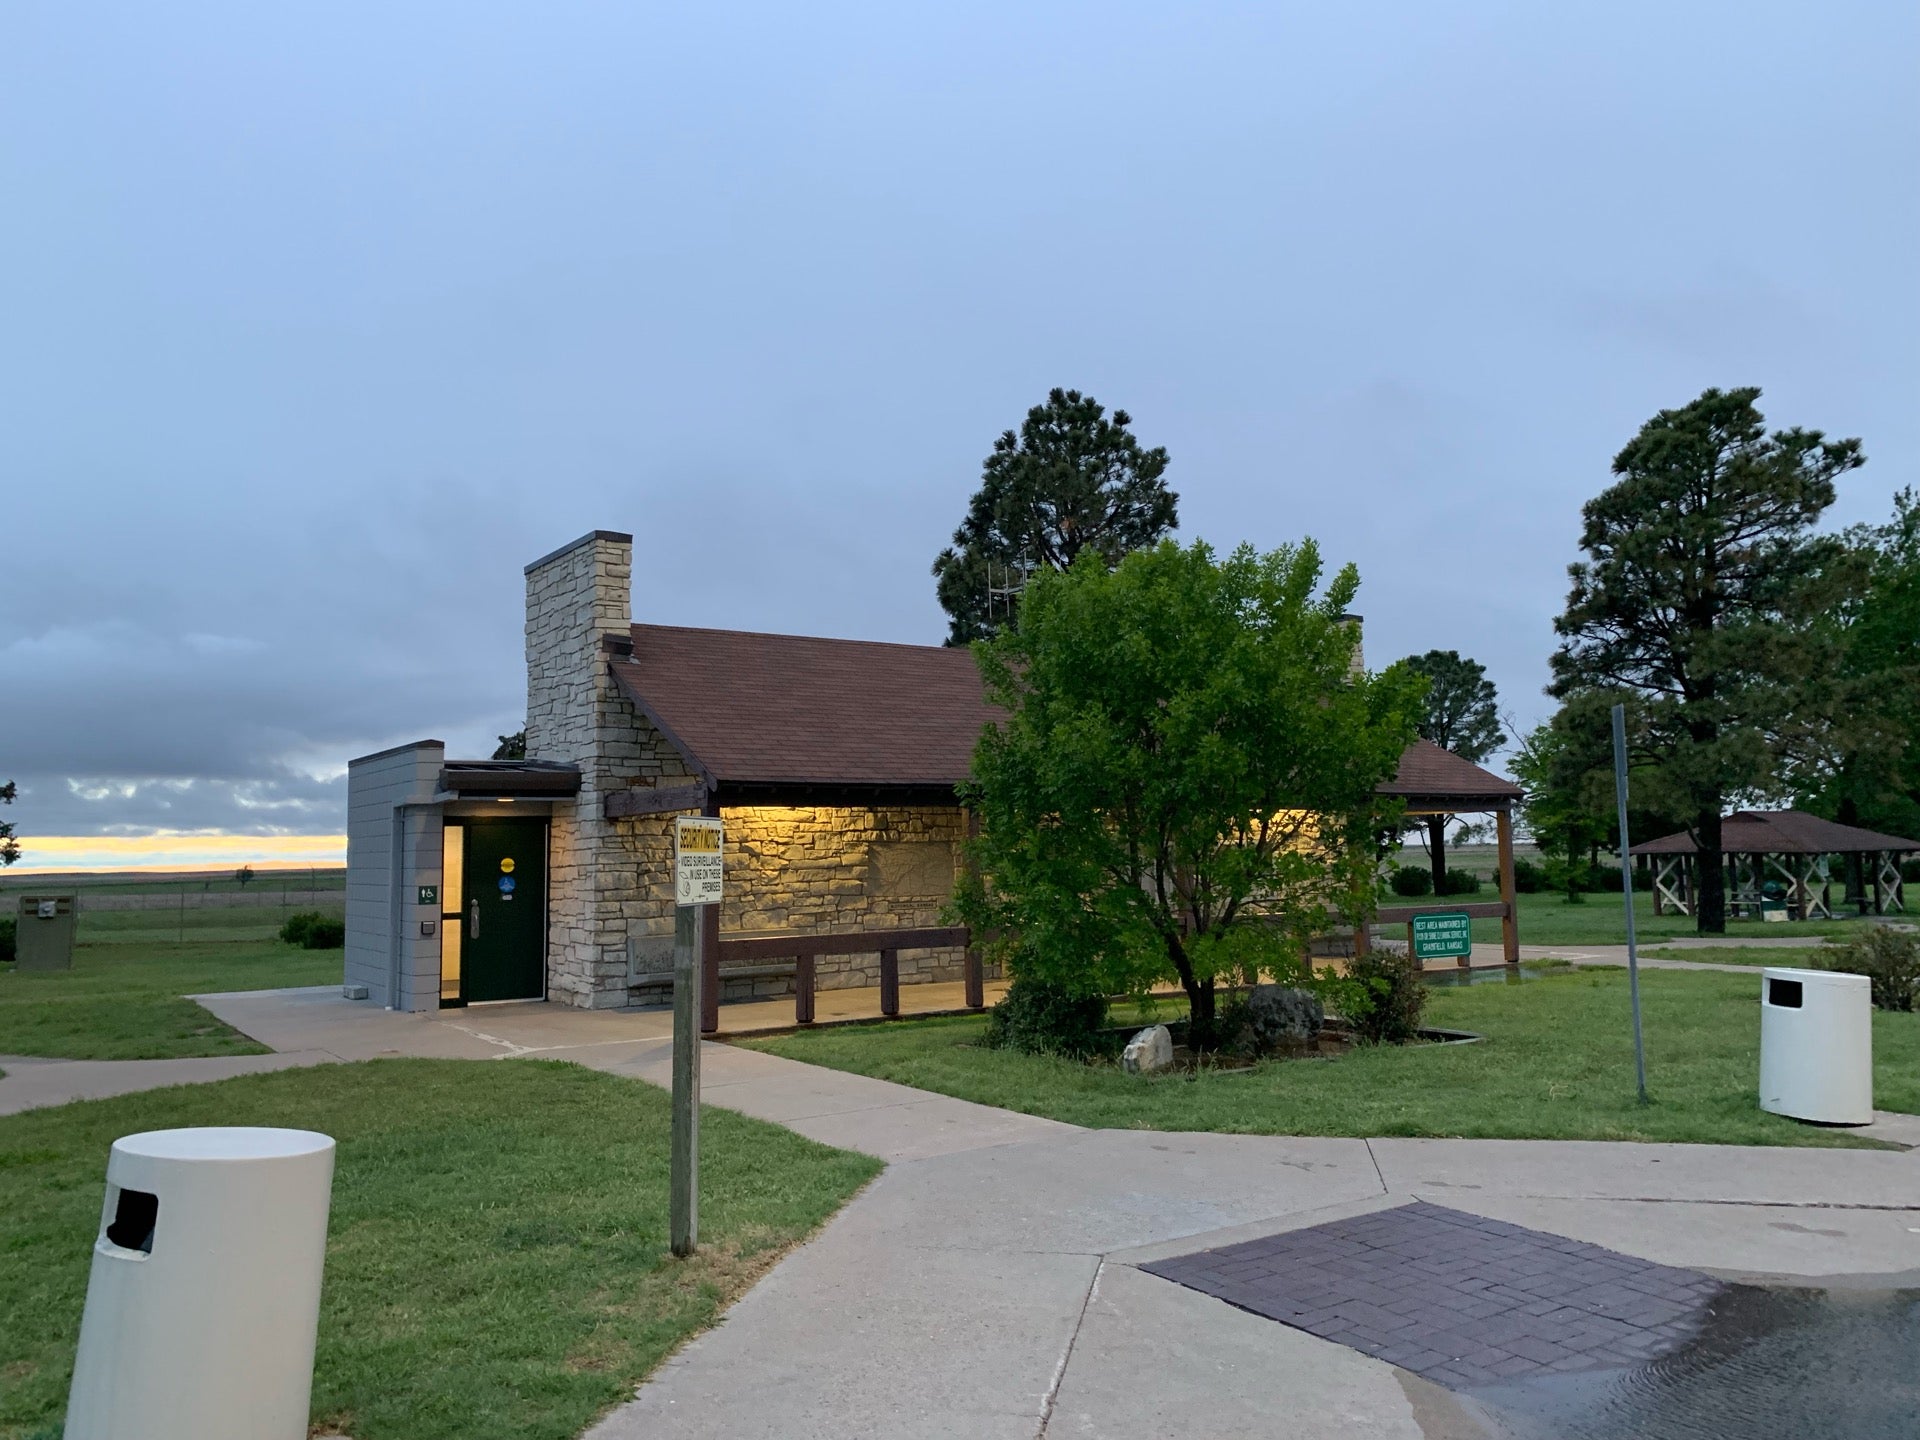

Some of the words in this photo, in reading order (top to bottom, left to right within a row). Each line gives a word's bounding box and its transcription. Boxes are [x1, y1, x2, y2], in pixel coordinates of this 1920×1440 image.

[680, 828, 704, 849] SECURITY
[704, 829, 721, 849] NOTICE
[681, 856, 693, 867] VIDEO
[693, 856, 721, 867] SURVEILLANCE
[694, 869, 702, 880] USE
[702, 869, 709, 880] ON
[709, 868, 721, 879] THESE
[702, 881, 721, 893] PREMISES
[1416, 921, 1426, 930] REST
[1427, 921, 1438, 930] AREA
[1438, 920, 1460, 929] MAINTAINED
[1461, 920, 1467, 928] BY
[1447, 941, 1463, 950] KANSAS
